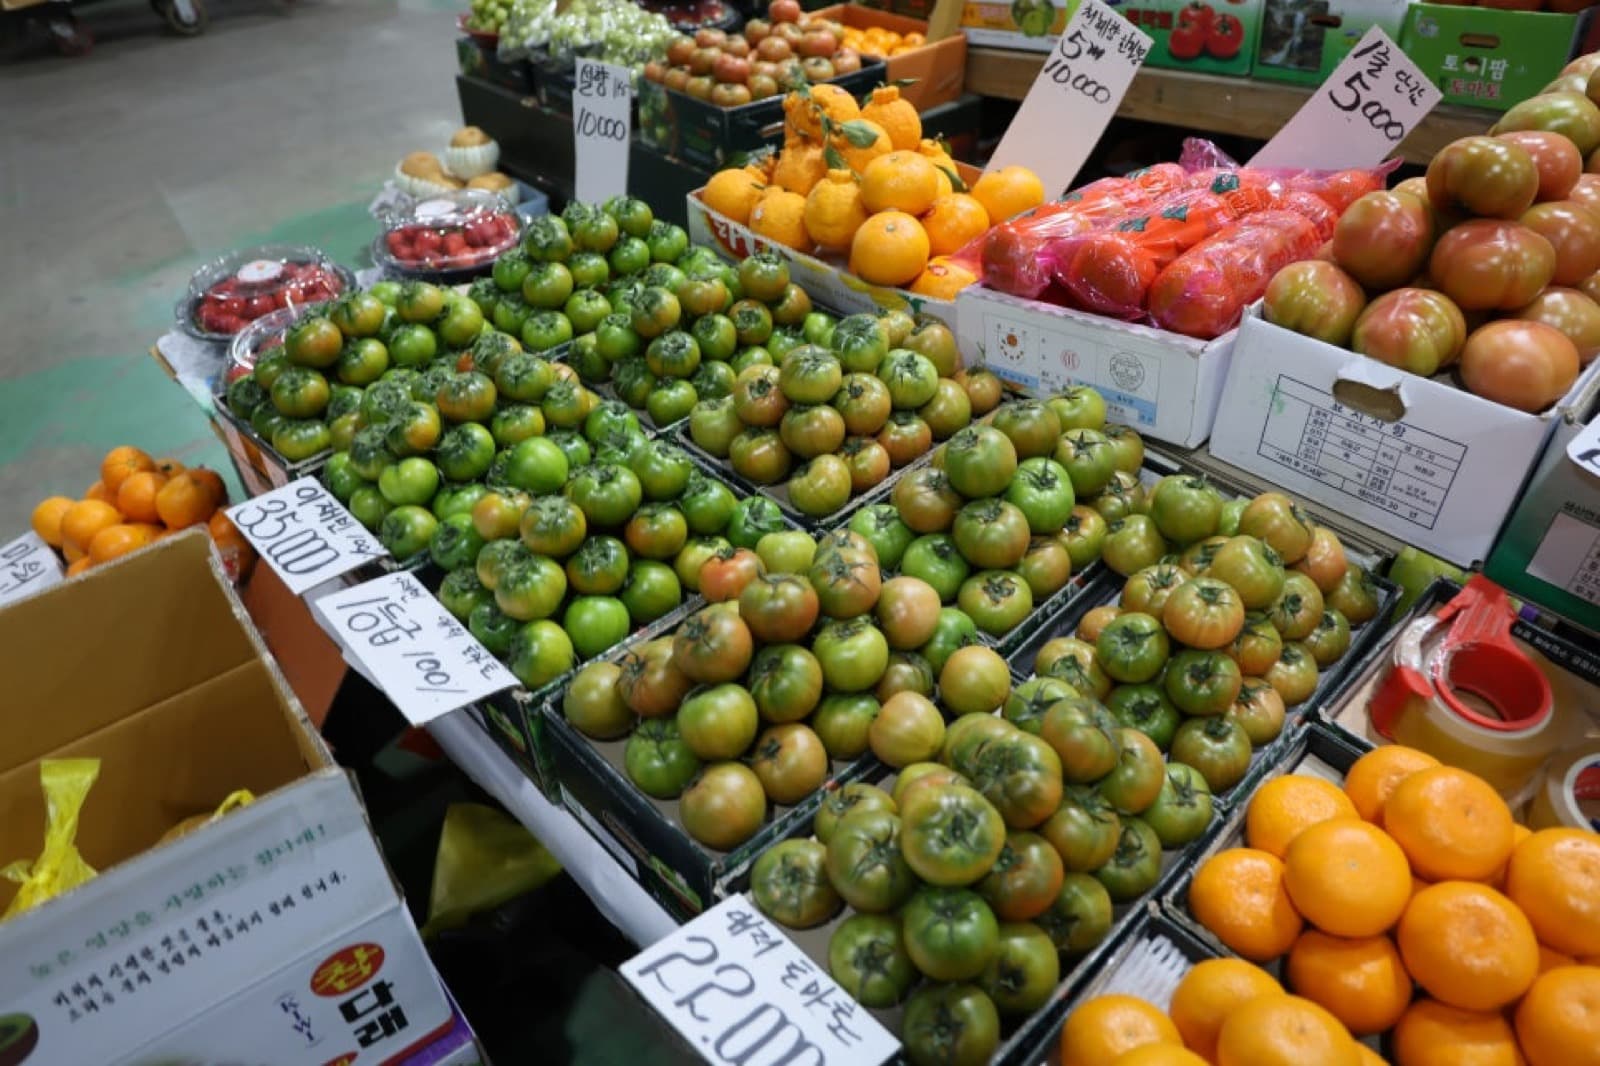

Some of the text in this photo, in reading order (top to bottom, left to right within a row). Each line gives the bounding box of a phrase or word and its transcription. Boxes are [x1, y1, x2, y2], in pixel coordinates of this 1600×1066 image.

[1452, 79, 1500, 98] 토마토
[576, 107, 626, 141] 10000
[726, 909, 863, 1047] 대저 토마토
